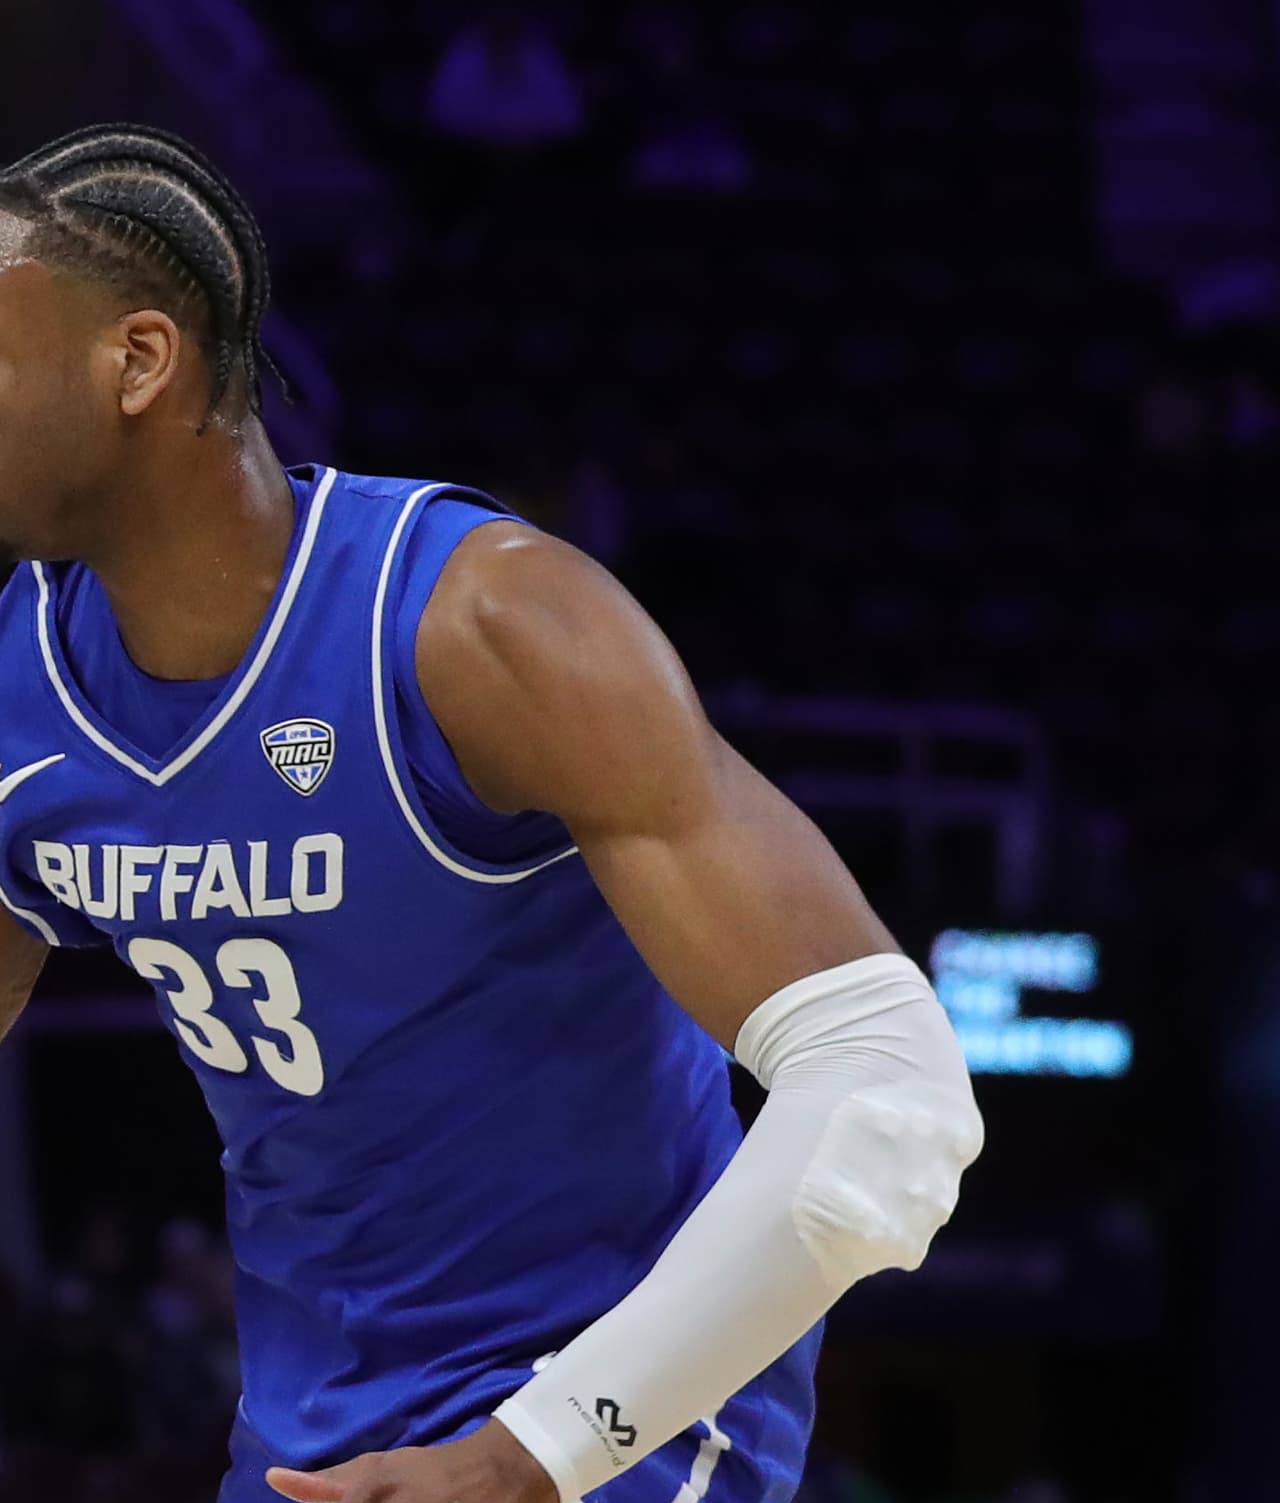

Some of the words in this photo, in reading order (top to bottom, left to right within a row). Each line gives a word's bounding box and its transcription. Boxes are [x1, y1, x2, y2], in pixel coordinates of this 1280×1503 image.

[271, 743, 332, 766] MAC
[32, 832, 344, 921] BUFFALO
[127, 937, 325, 1097] 33
